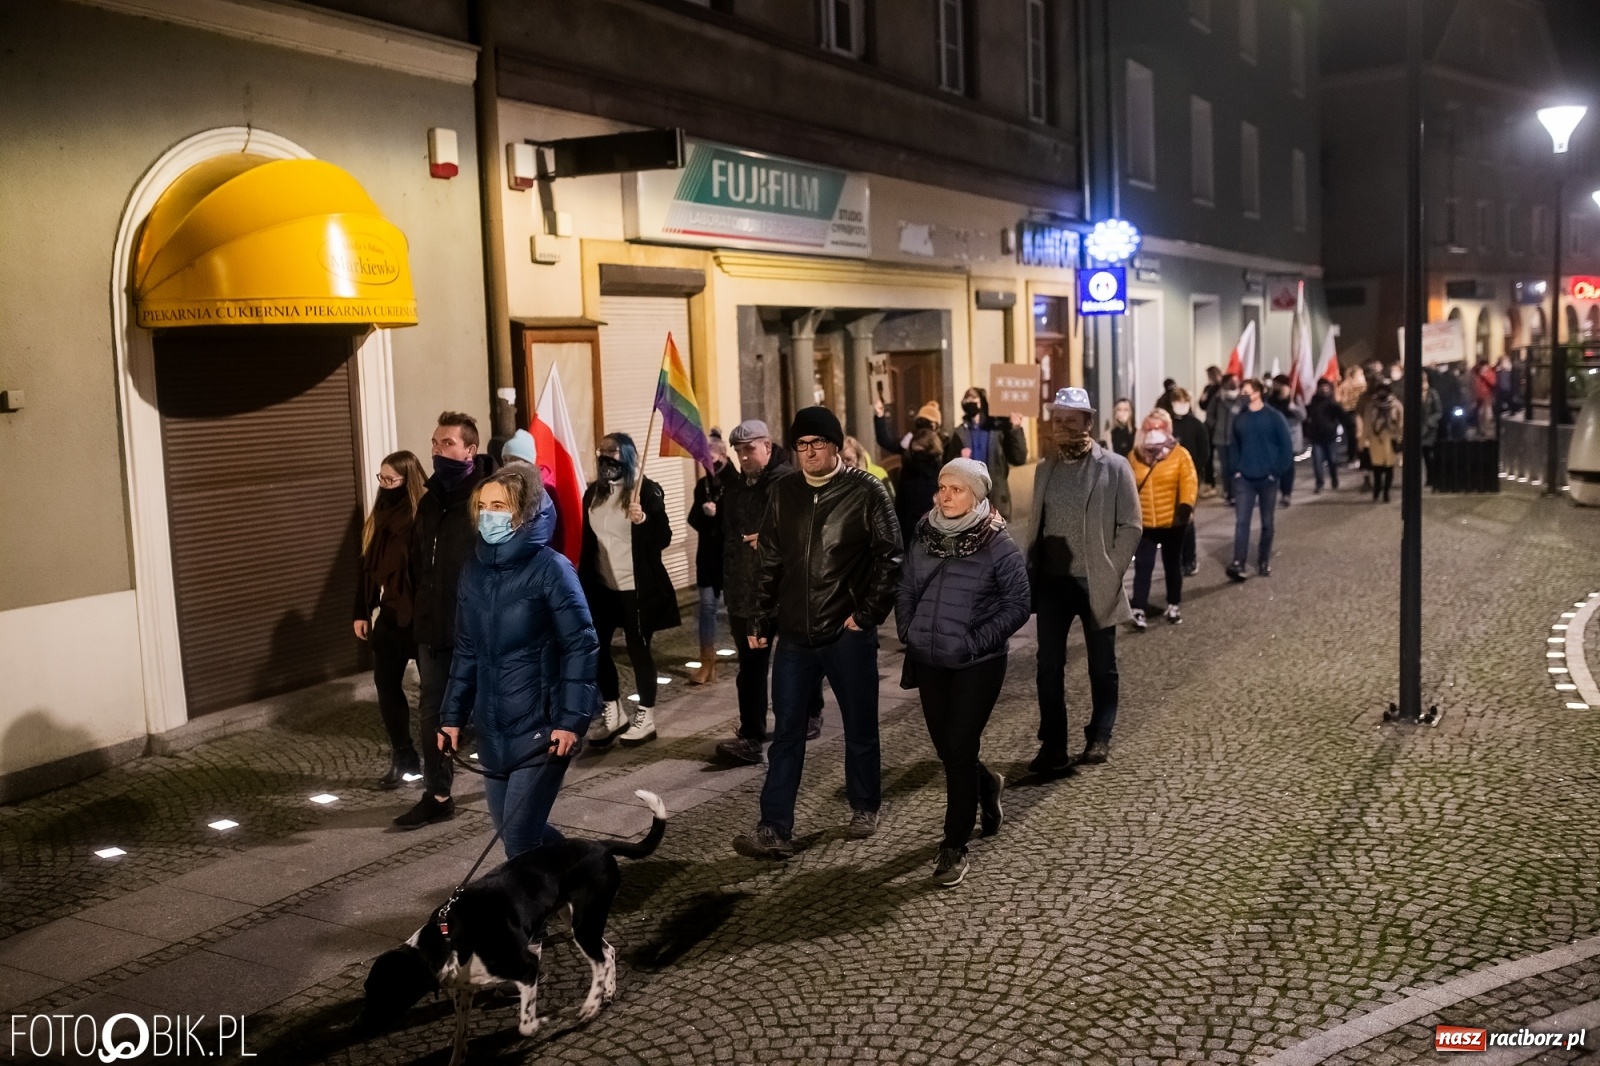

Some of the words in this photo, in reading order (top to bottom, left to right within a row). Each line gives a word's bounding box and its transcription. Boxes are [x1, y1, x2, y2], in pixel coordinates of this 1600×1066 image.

[712, 159, 819, 212] FUJIFILM
[330, 255, 396, 275] Markiewka
[142, 306, 211, 321] PIEKARNIA
[216, 305, 300, 318] CUKIERNIA
[305, 305, 371, 317] PIEKARNIA
